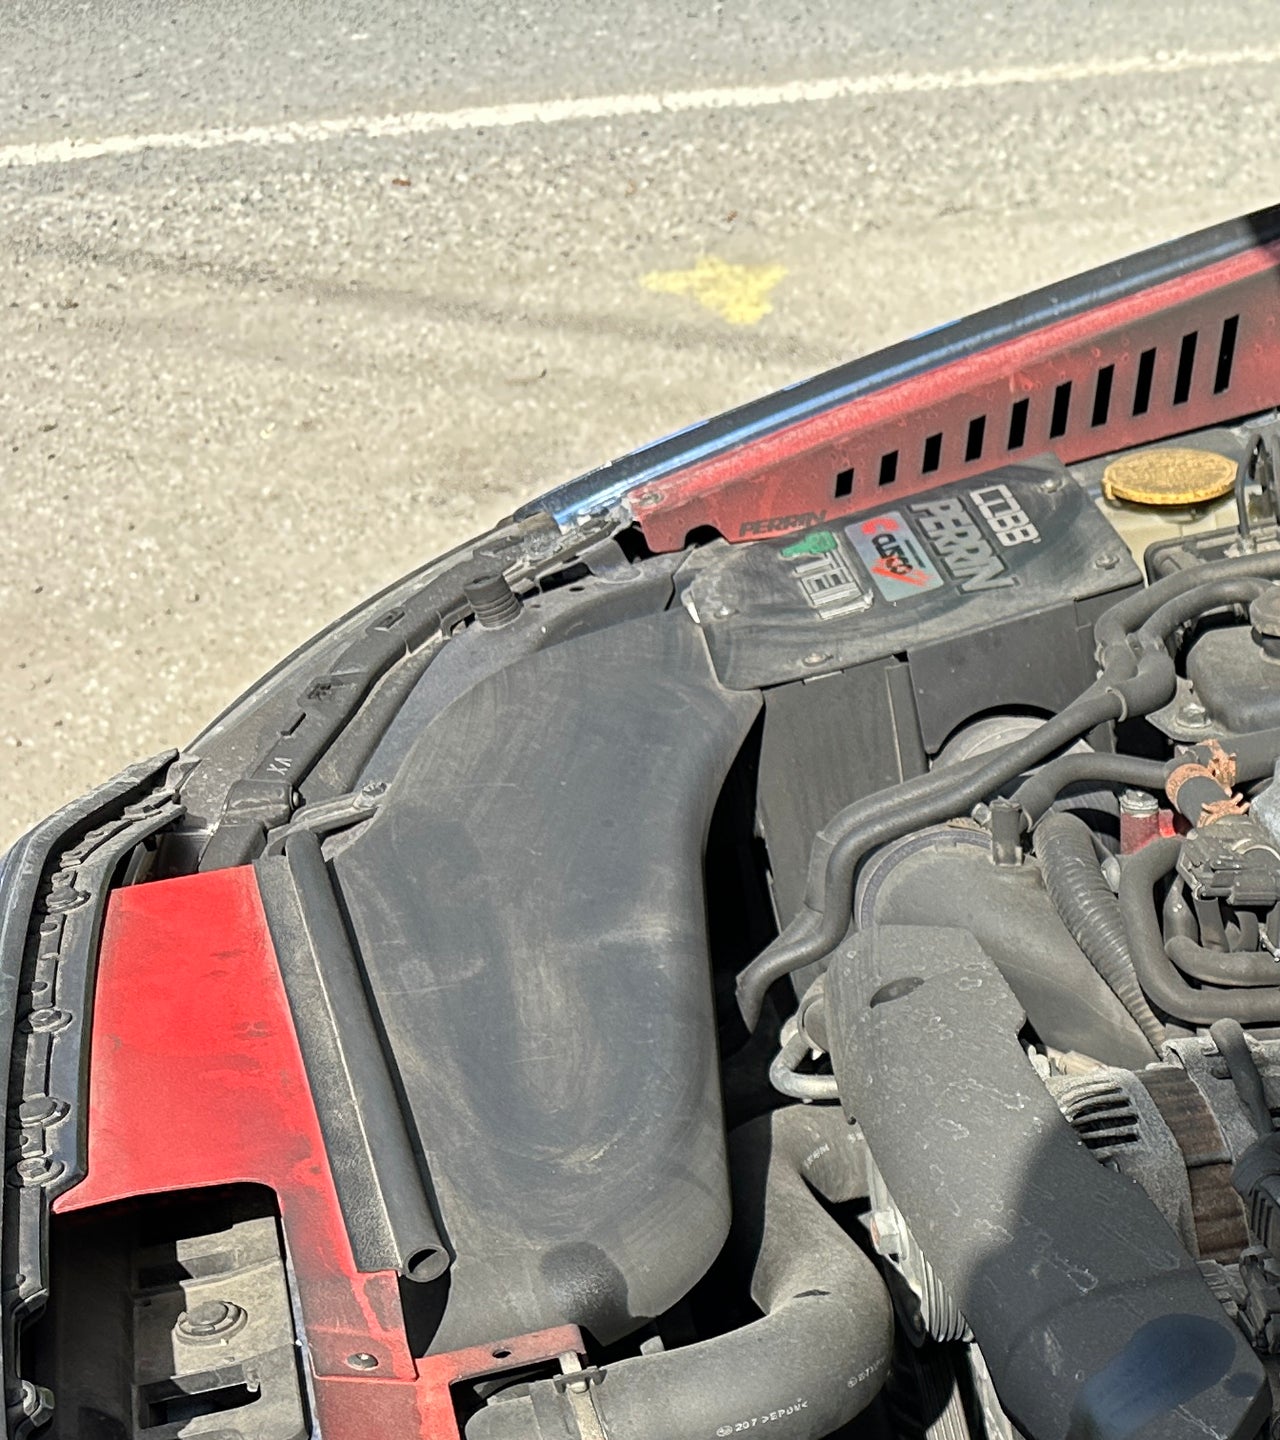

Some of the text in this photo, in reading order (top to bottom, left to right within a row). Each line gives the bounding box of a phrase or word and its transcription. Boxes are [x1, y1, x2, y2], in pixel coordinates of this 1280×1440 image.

[739, 510, 827, 537] PERRIN
[969, 484, 1040, 547] COBB
[907, 497, 1020, 593] PERRIN
[735, 1417, 758, 1433] 207
